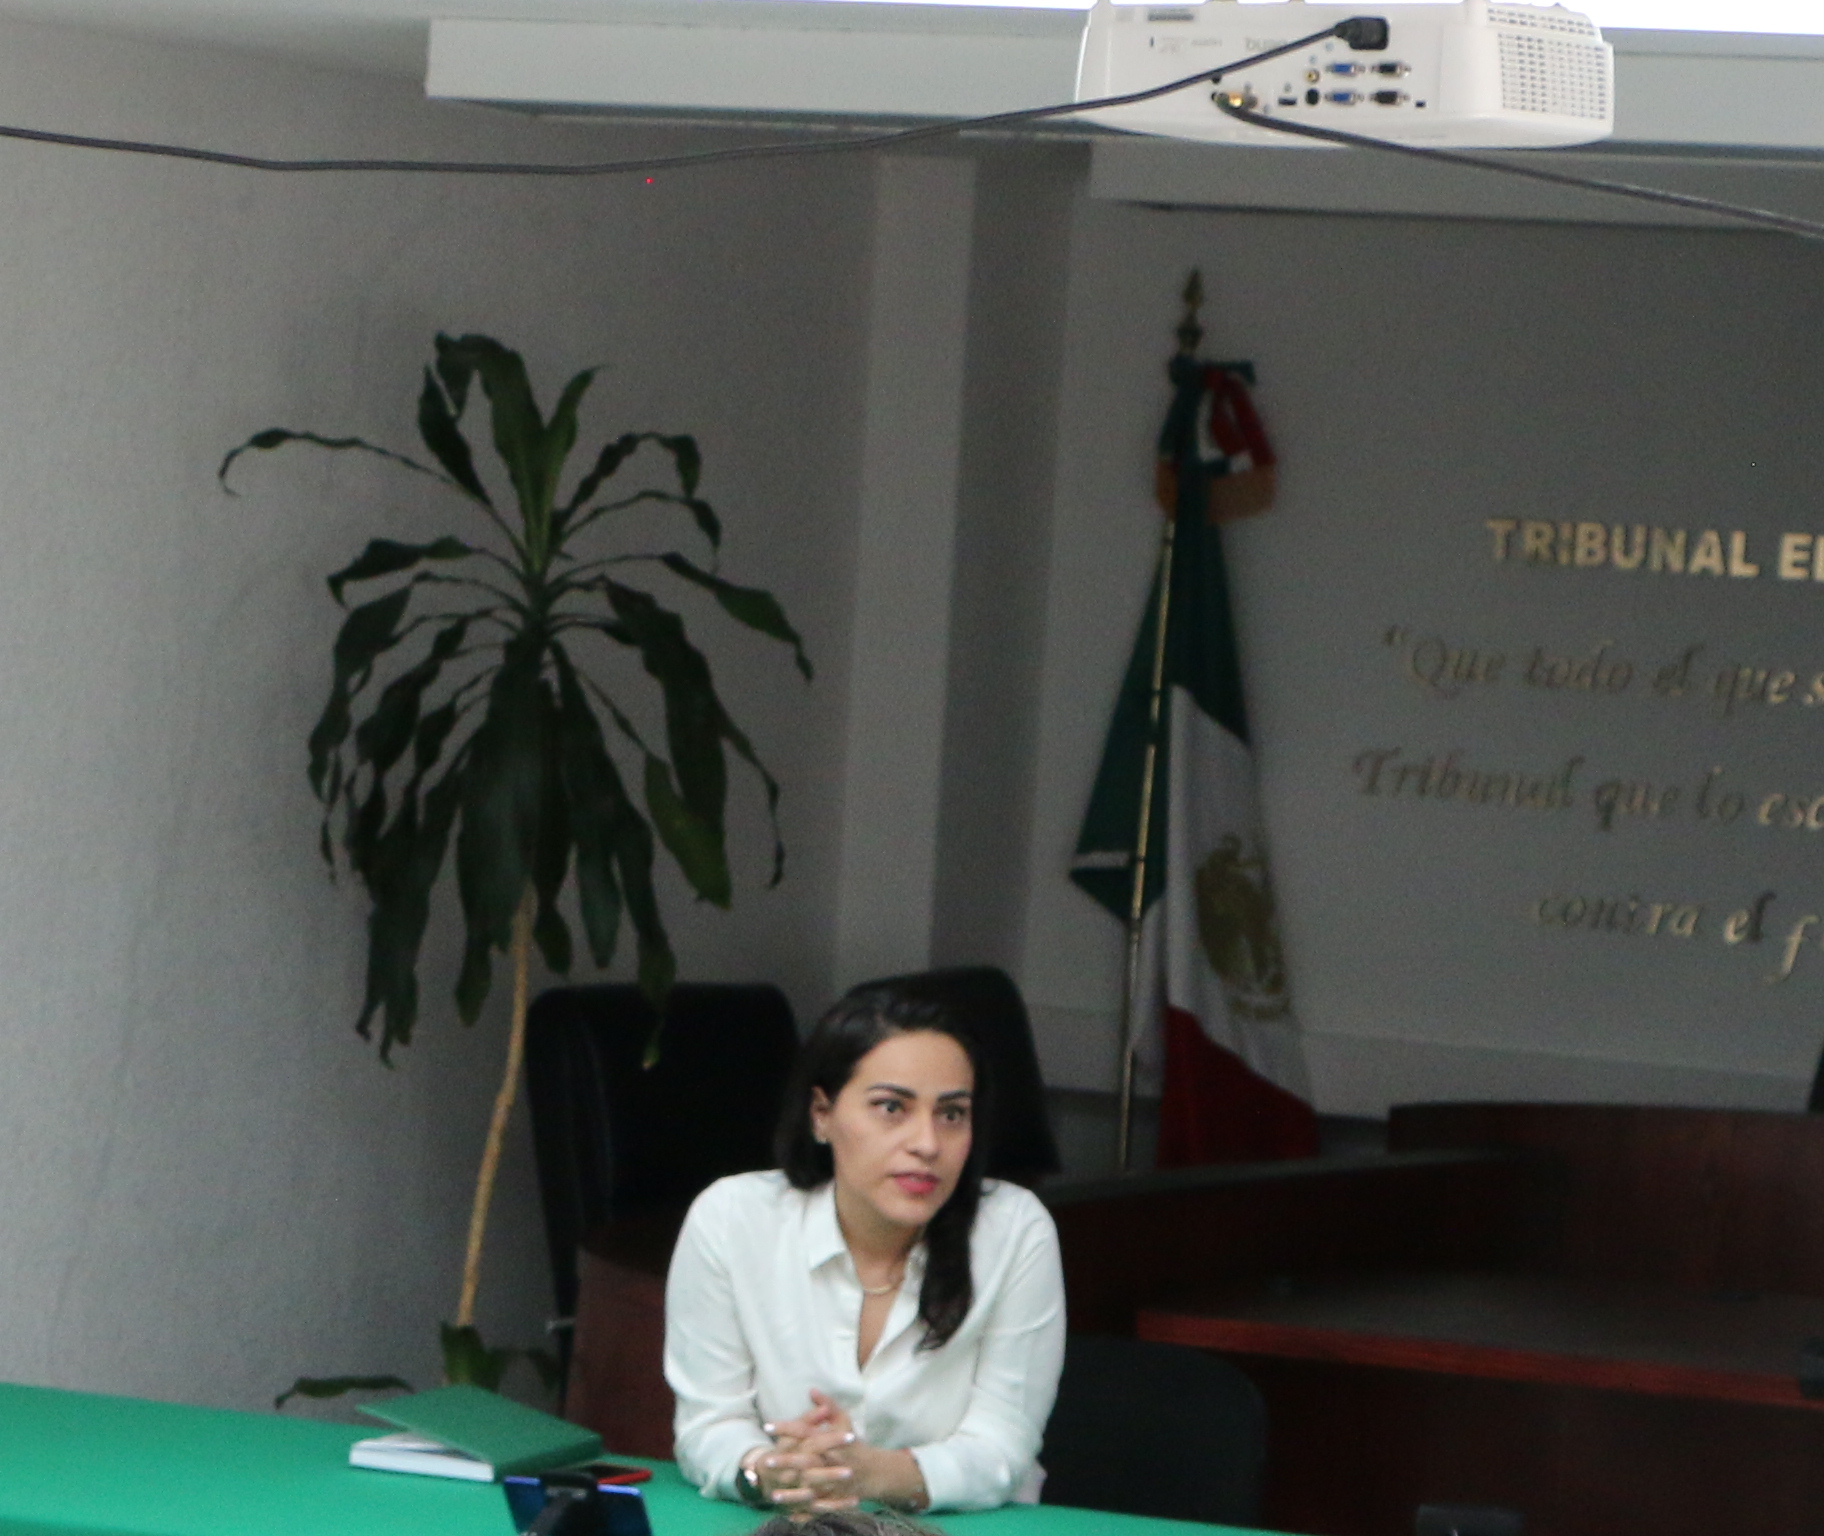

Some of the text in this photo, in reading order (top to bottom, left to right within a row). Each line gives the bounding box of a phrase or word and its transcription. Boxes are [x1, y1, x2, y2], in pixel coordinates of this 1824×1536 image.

[1485, 519, 1761, 580] TRIBUNAL
[1524, 636, 1633, 695] todo
[1653, 645, 1705, 697] el
[1713, 660, 1796, 717] que
[1353, 747, 1584, 811] Tribunal
[1593, 775, 1679, 833] que
[1695, 766, 1746, 825] lo
[1533, 893, 1700, 941] contra
[1723, 891, 1778, 944] el
